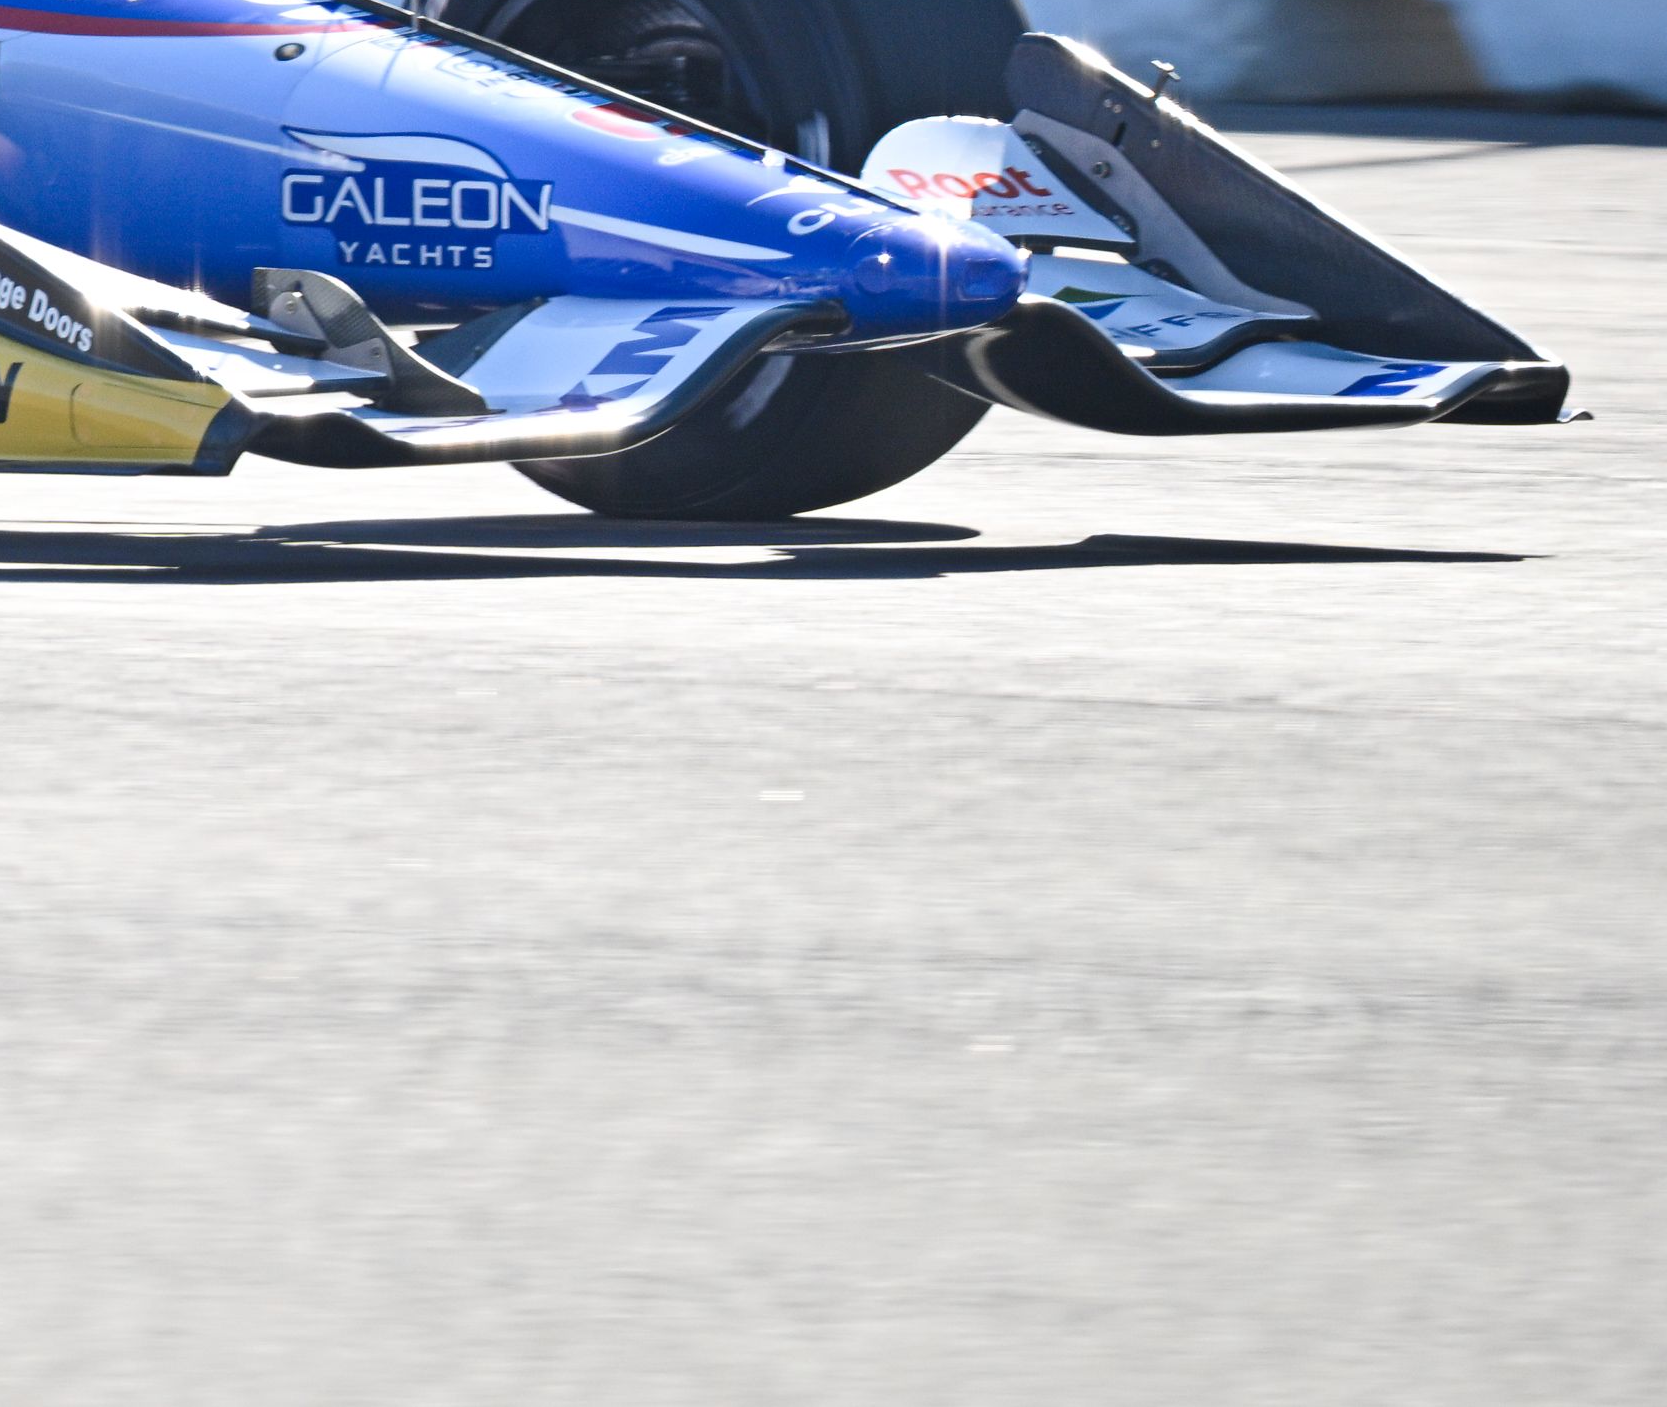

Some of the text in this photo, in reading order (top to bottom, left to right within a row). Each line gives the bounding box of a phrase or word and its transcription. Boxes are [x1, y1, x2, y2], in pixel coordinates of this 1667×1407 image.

[282, 173, 553, 231] GALEON
[886, 166, 1053, 200] Root
[339, 241, 494, 269] YACHTS
[28, 289, 93, 353] Doors
